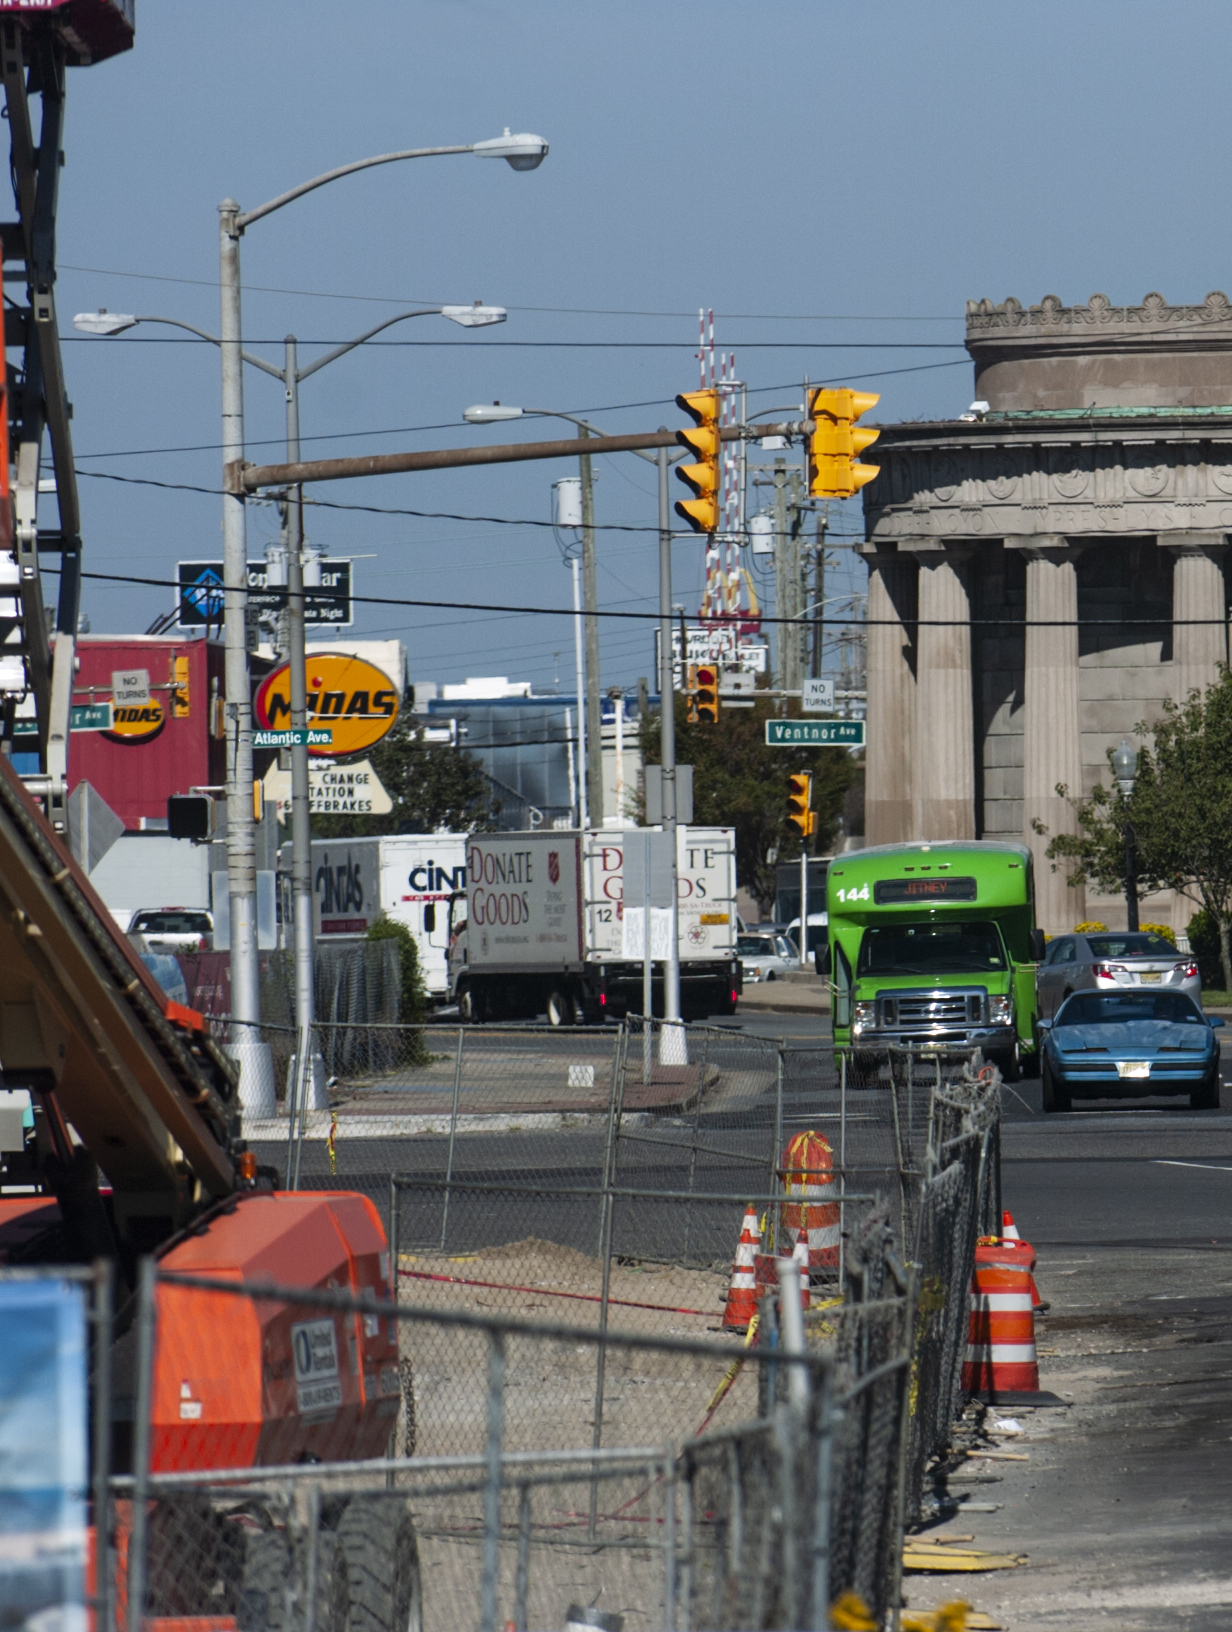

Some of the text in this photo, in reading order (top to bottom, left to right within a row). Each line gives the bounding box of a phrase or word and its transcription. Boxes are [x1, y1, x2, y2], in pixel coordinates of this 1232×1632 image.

[122, 676, 138, 686] NO
[117, 689, 147, 700] TURNS
[811, 684, 826, 694] NO
[805, 697, 832, 707] TURNS
[85, 710, 102, 720] Ave
[254, 731, 333, 746] Atlantic Ave.
[775, 725, 856, 740] Ventnor Ave
[322, 773, 370, 785] CHANGE
[309, 786, 355, 798] TATION
[470, 846, 533, 885] DONATE
[836, 887, 870, 902] 144
[904, 882, 948, 895] JITNEY
[472, 887, 530, 925] GOODS
[596, 909, 613, 923] 12
